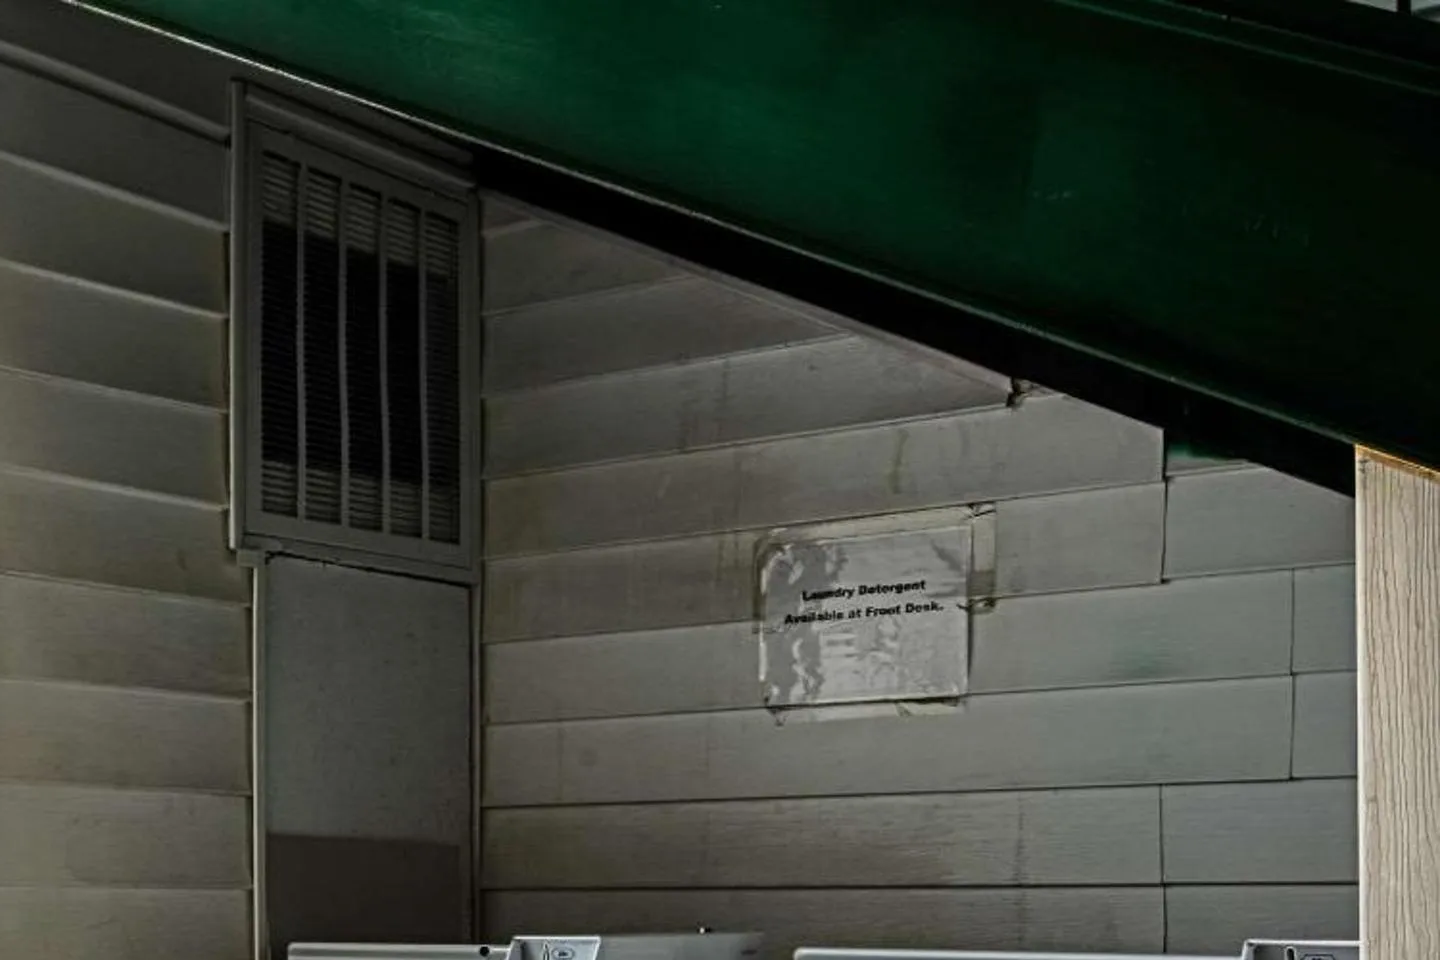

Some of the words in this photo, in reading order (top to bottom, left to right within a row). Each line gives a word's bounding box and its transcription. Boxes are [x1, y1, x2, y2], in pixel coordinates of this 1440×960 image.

[802, 586, 855, 601] Laundry
[859, 580, 926, 596] Detergent
[784, 610, 844, 625] Available
[848, 607, 862, 619] at
[866, 606, 902, 618] Front
